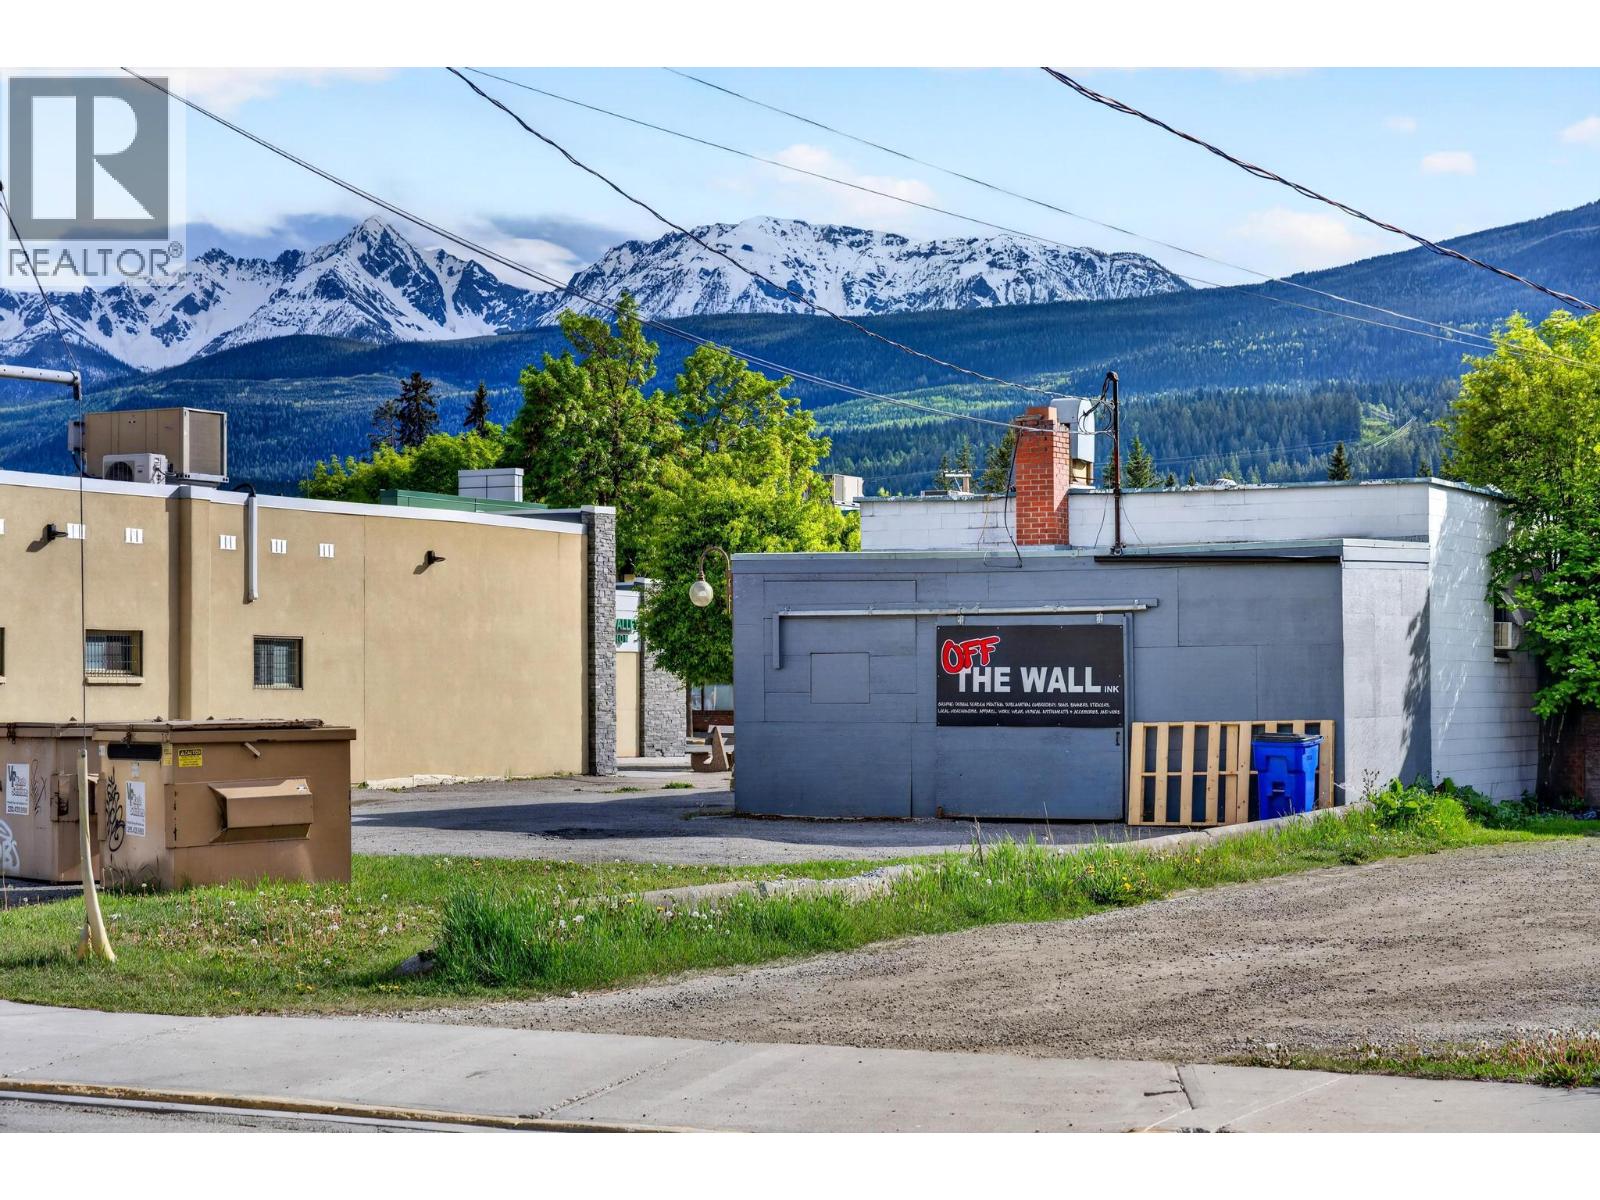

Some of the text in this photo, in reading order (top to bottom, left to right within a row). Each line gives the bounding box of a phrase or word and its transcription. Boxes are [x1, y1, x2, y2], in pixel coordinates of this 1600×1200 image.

[941, 635, 1000, 675] OFF
[958, 666, 1119, 694] THE WALL INK
